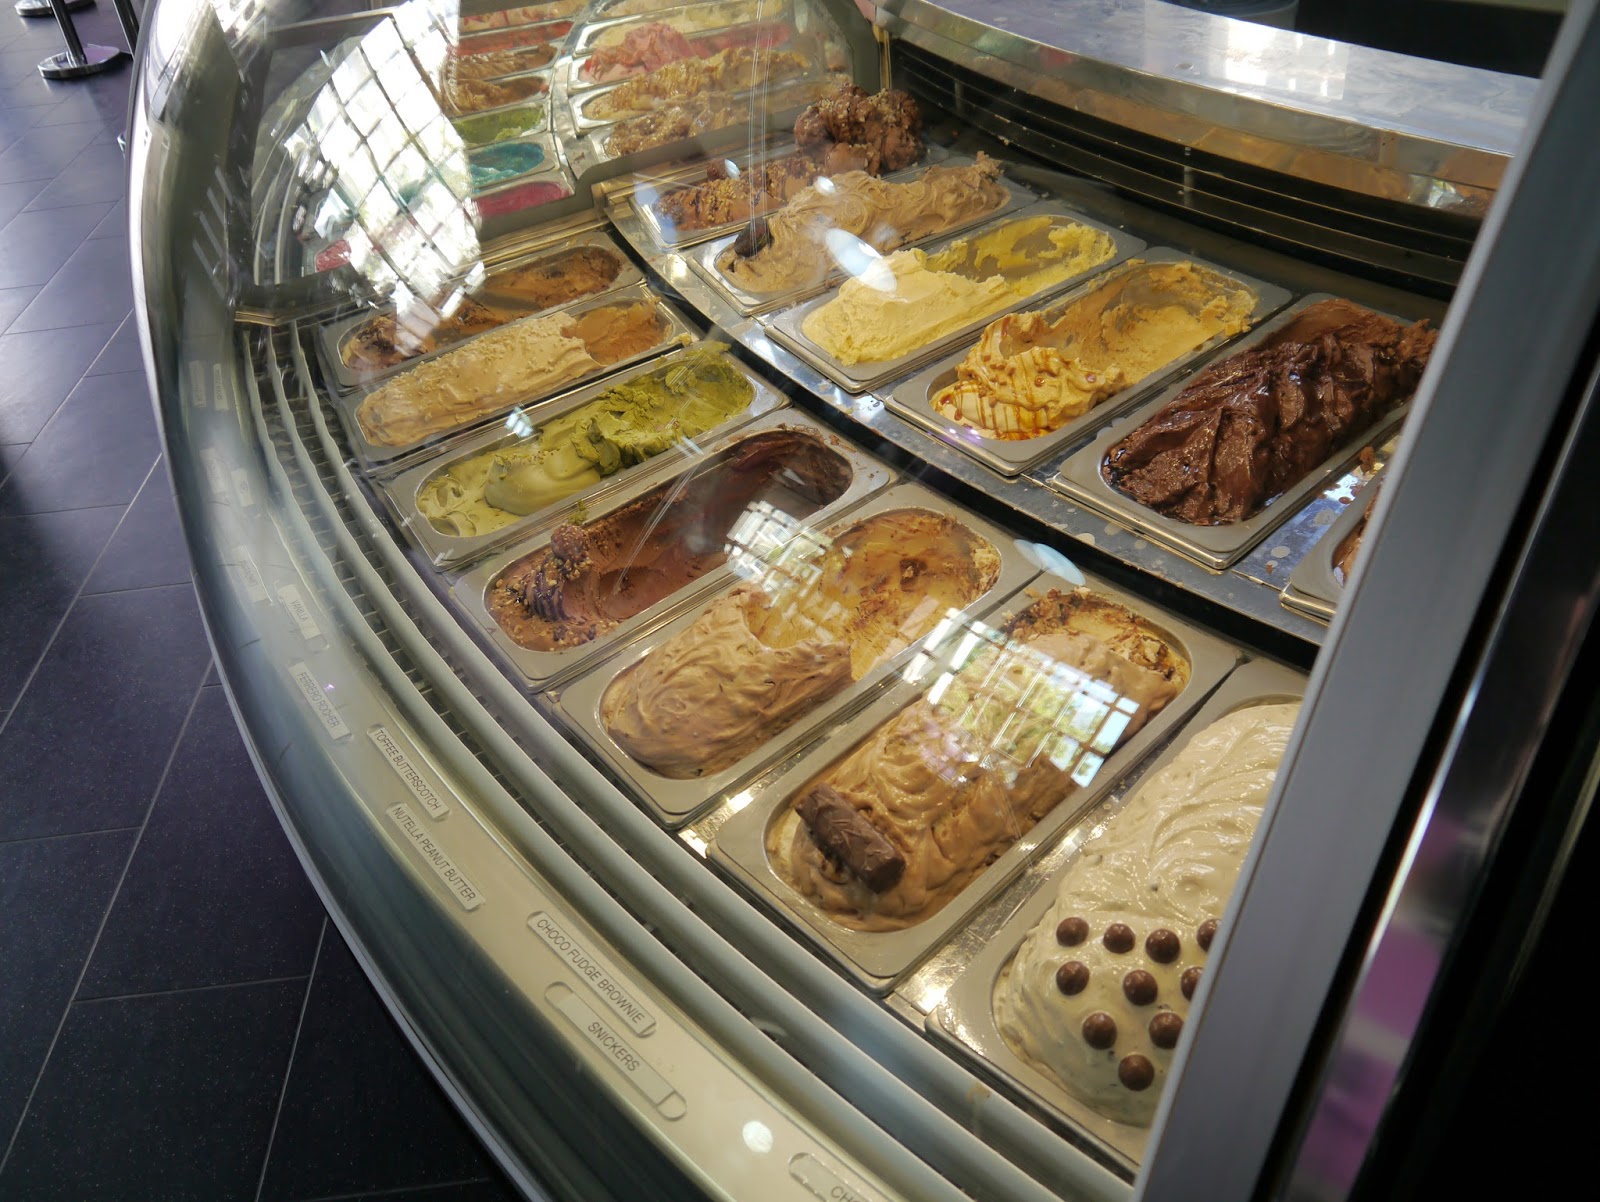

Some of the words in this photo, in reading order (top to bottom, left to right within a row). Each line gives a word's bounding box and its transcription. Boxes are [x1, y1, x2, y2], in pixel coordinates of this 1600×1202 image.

[290, 600, 309, 622] VANILLA
[297, 672, 322, 702] FERRERO
[318, 698, 340, 728] ROCHER
[374, 729, 399, 757] TOFFEE
[393, 755, 442, 811] BUTTERSCOTCH
[392, 807, 424, 842] NUTELLA
[419, 839, 451, 870] PEANUT
[444, 868, 476, 902] BUTTER
[537, 919, 571, 951] CHOCO
[568, 948, 602, 981] FUDGE
[597, 978, 646, 1024] BROWNIE
[588, 1021, 640, 1072] SNICKERS
